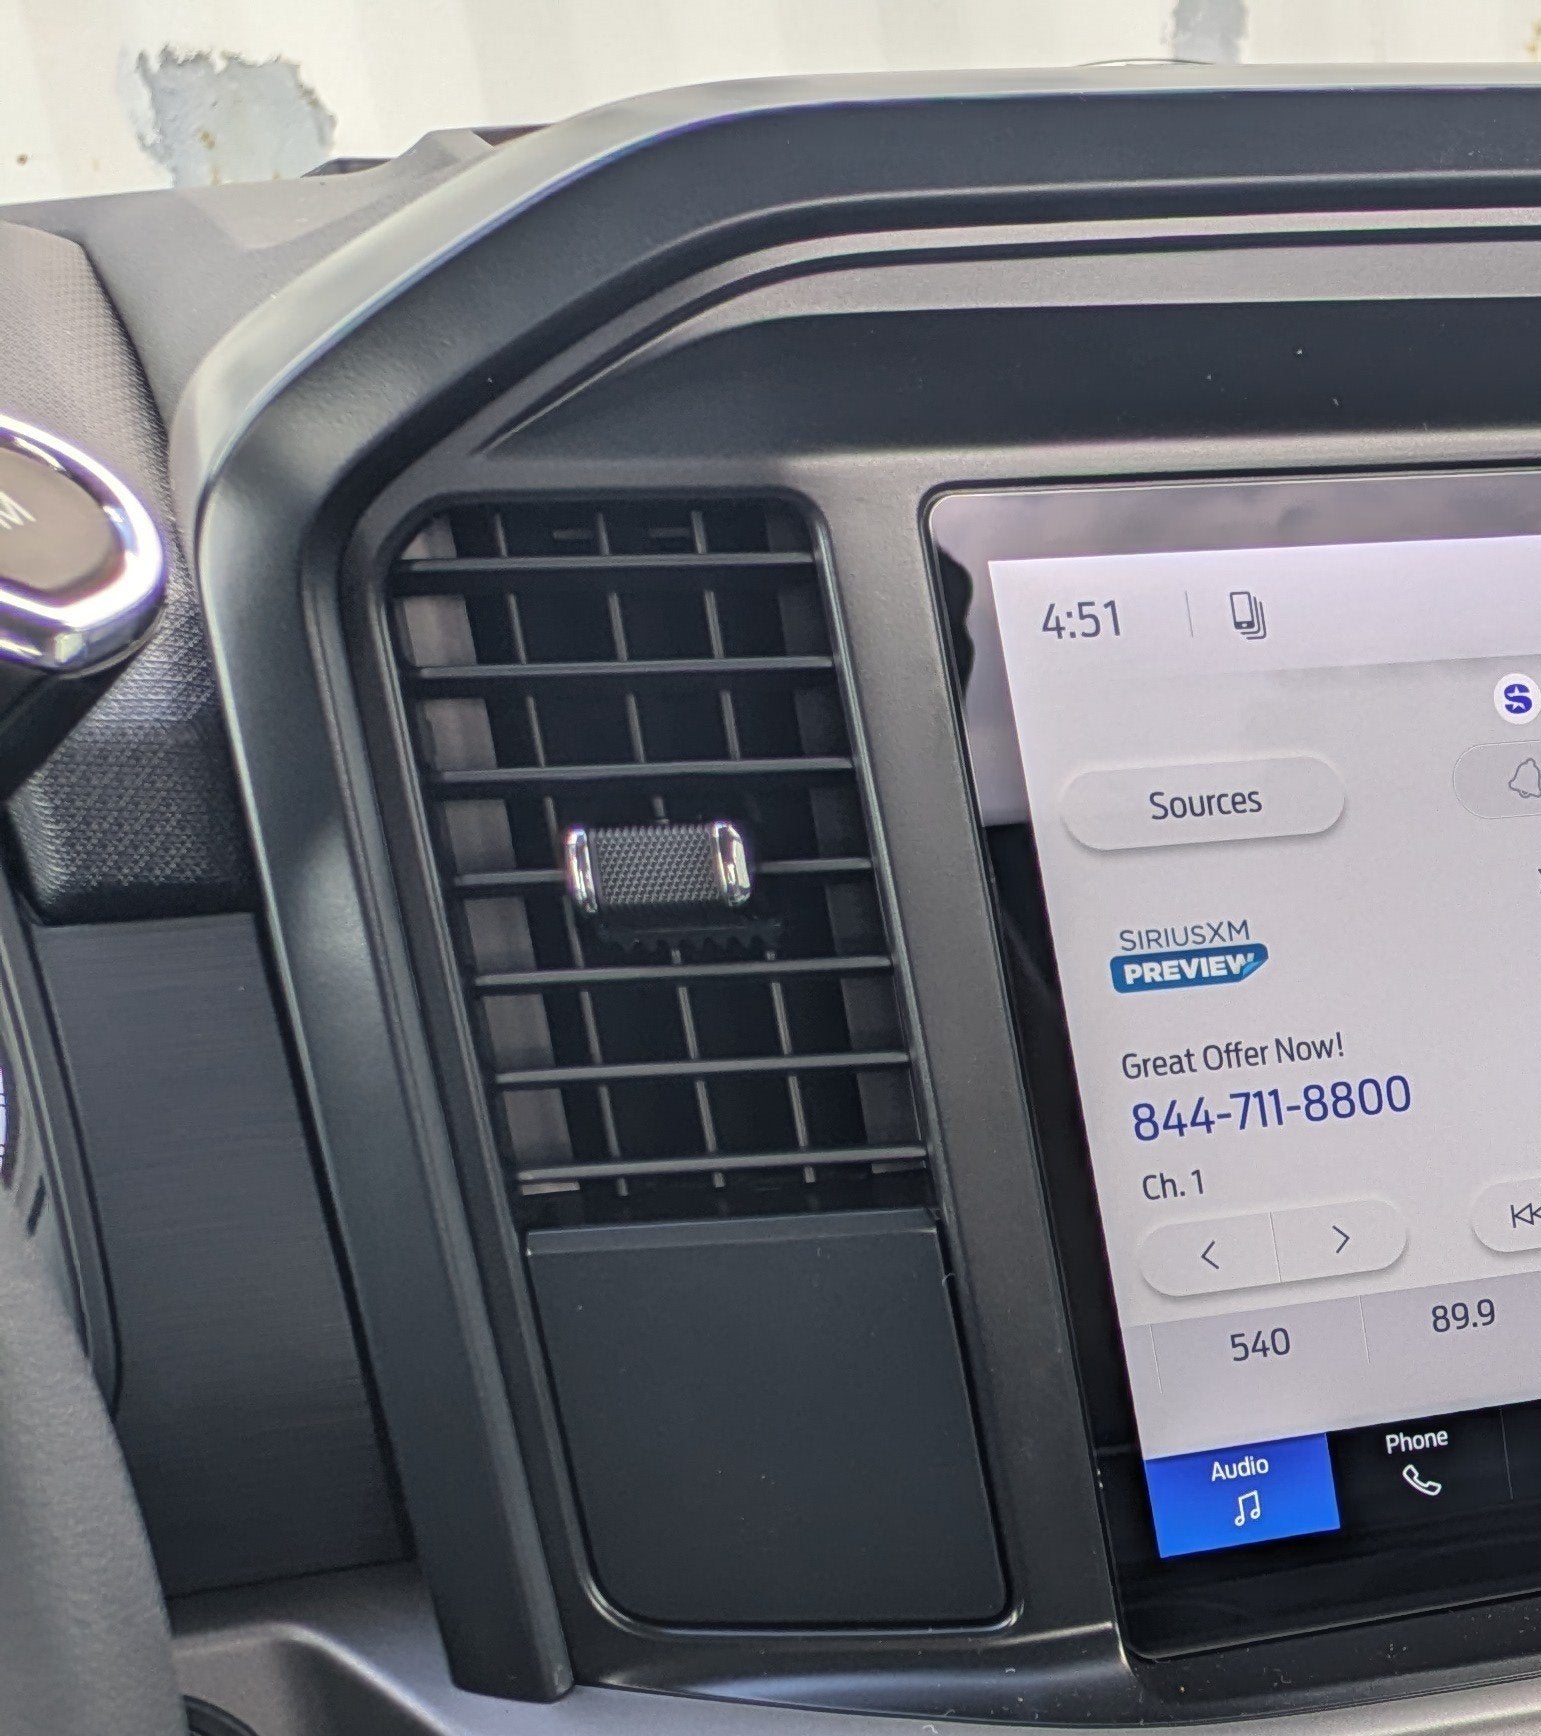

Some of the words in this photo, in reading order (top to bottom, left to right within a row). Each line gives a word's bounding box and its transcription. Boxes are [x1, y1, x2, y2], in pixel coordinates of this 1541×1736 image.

[1041, 599, 1122, 640] 4:51
[1149, 790, 1263, 821] Sources
[1119, 919, 1250, 951] SIRIUSXM
[1124, 953, 1255, 985] PREVIEW
[1121, 1048, 1196, 1080] Great
[1202, 1041, 1269, 1072] Offer
[1275, 1032, 1345, 1063] Now!
[1133, 1075, 1412, 1141] 844-711-8800
[1142, 1171, 1186, 1200] Ch.
[1191, 1169, 1205, 1195] 1
[1431, 1299, 1496, 1333] 89.9
[1230, 1328, 1290, 1361] 540
[1386, 1426, 1448, 1454] Phone
[1210, 1454, 1269, 1481] Audio
